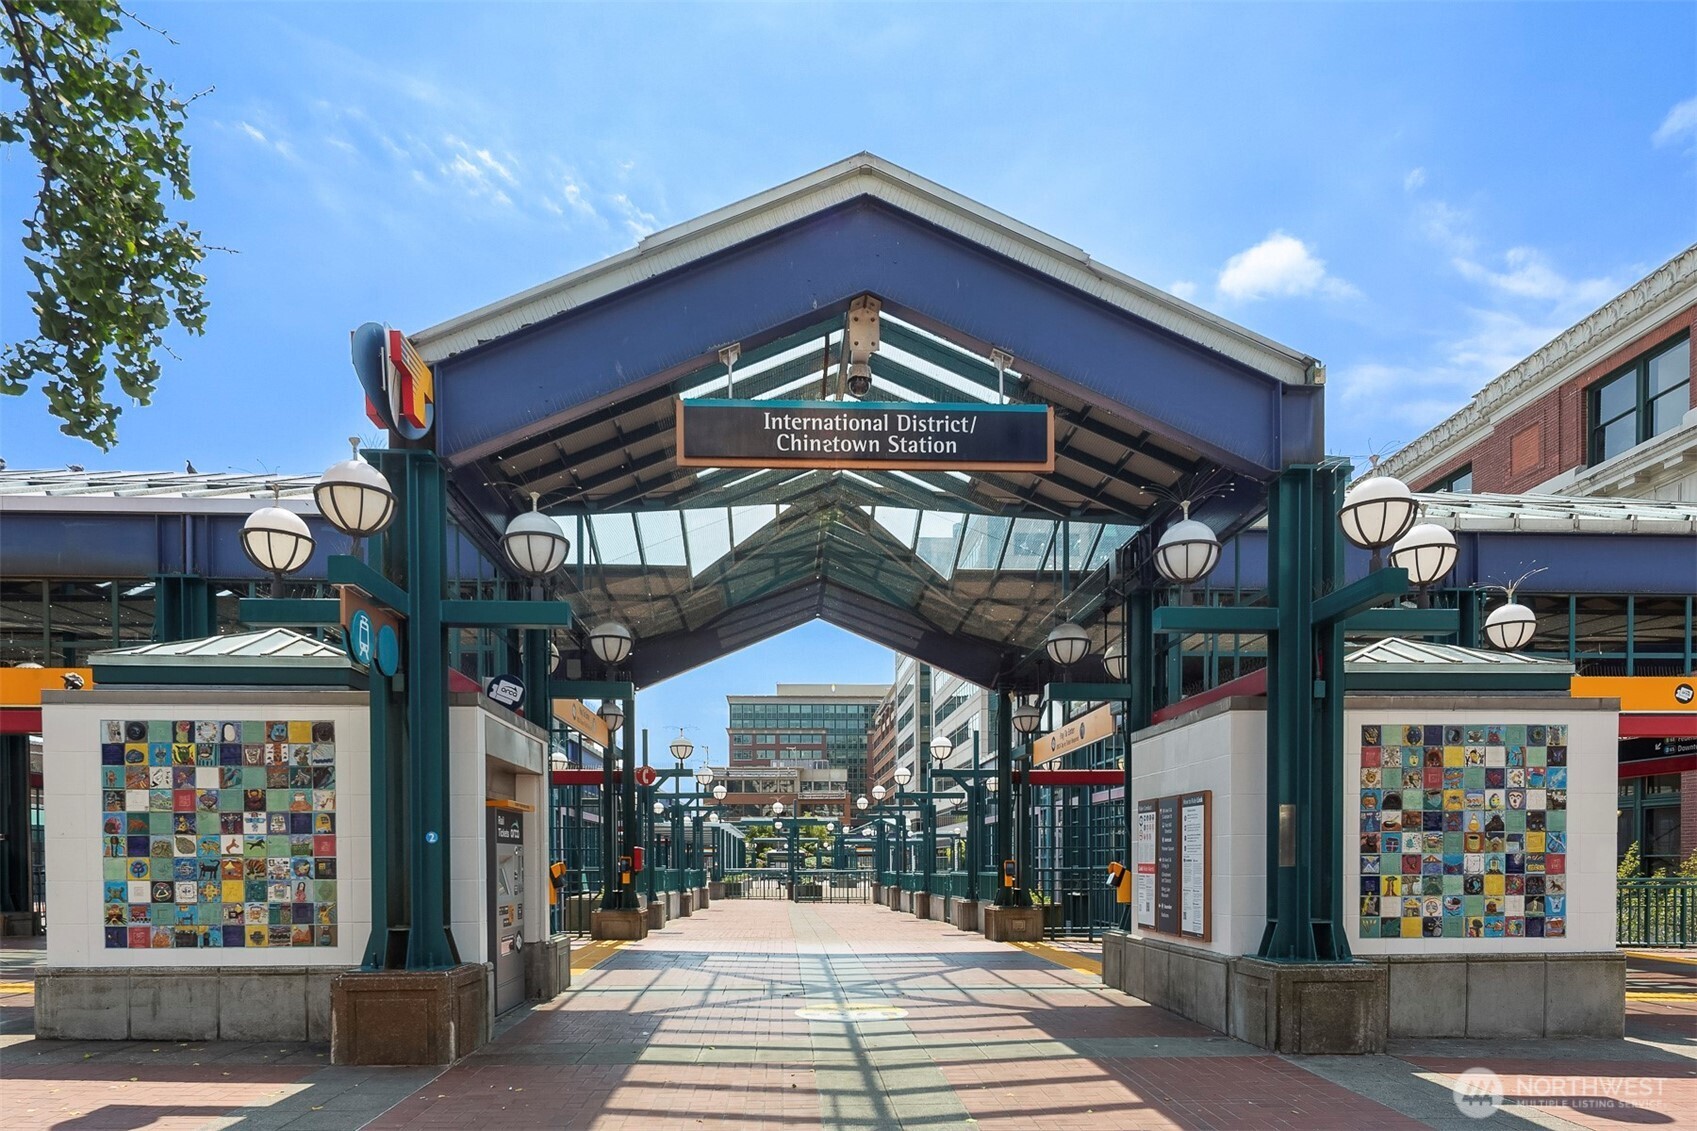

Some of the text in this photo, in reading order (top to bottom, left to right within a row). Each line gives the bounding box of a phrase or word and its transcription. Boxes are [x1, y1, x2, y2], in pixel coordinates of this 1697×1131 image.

[763, 412, 978, 434] International District/
[776, 433, 957, 454] Chinatown Station
[501, 687, 518, 698] orca
